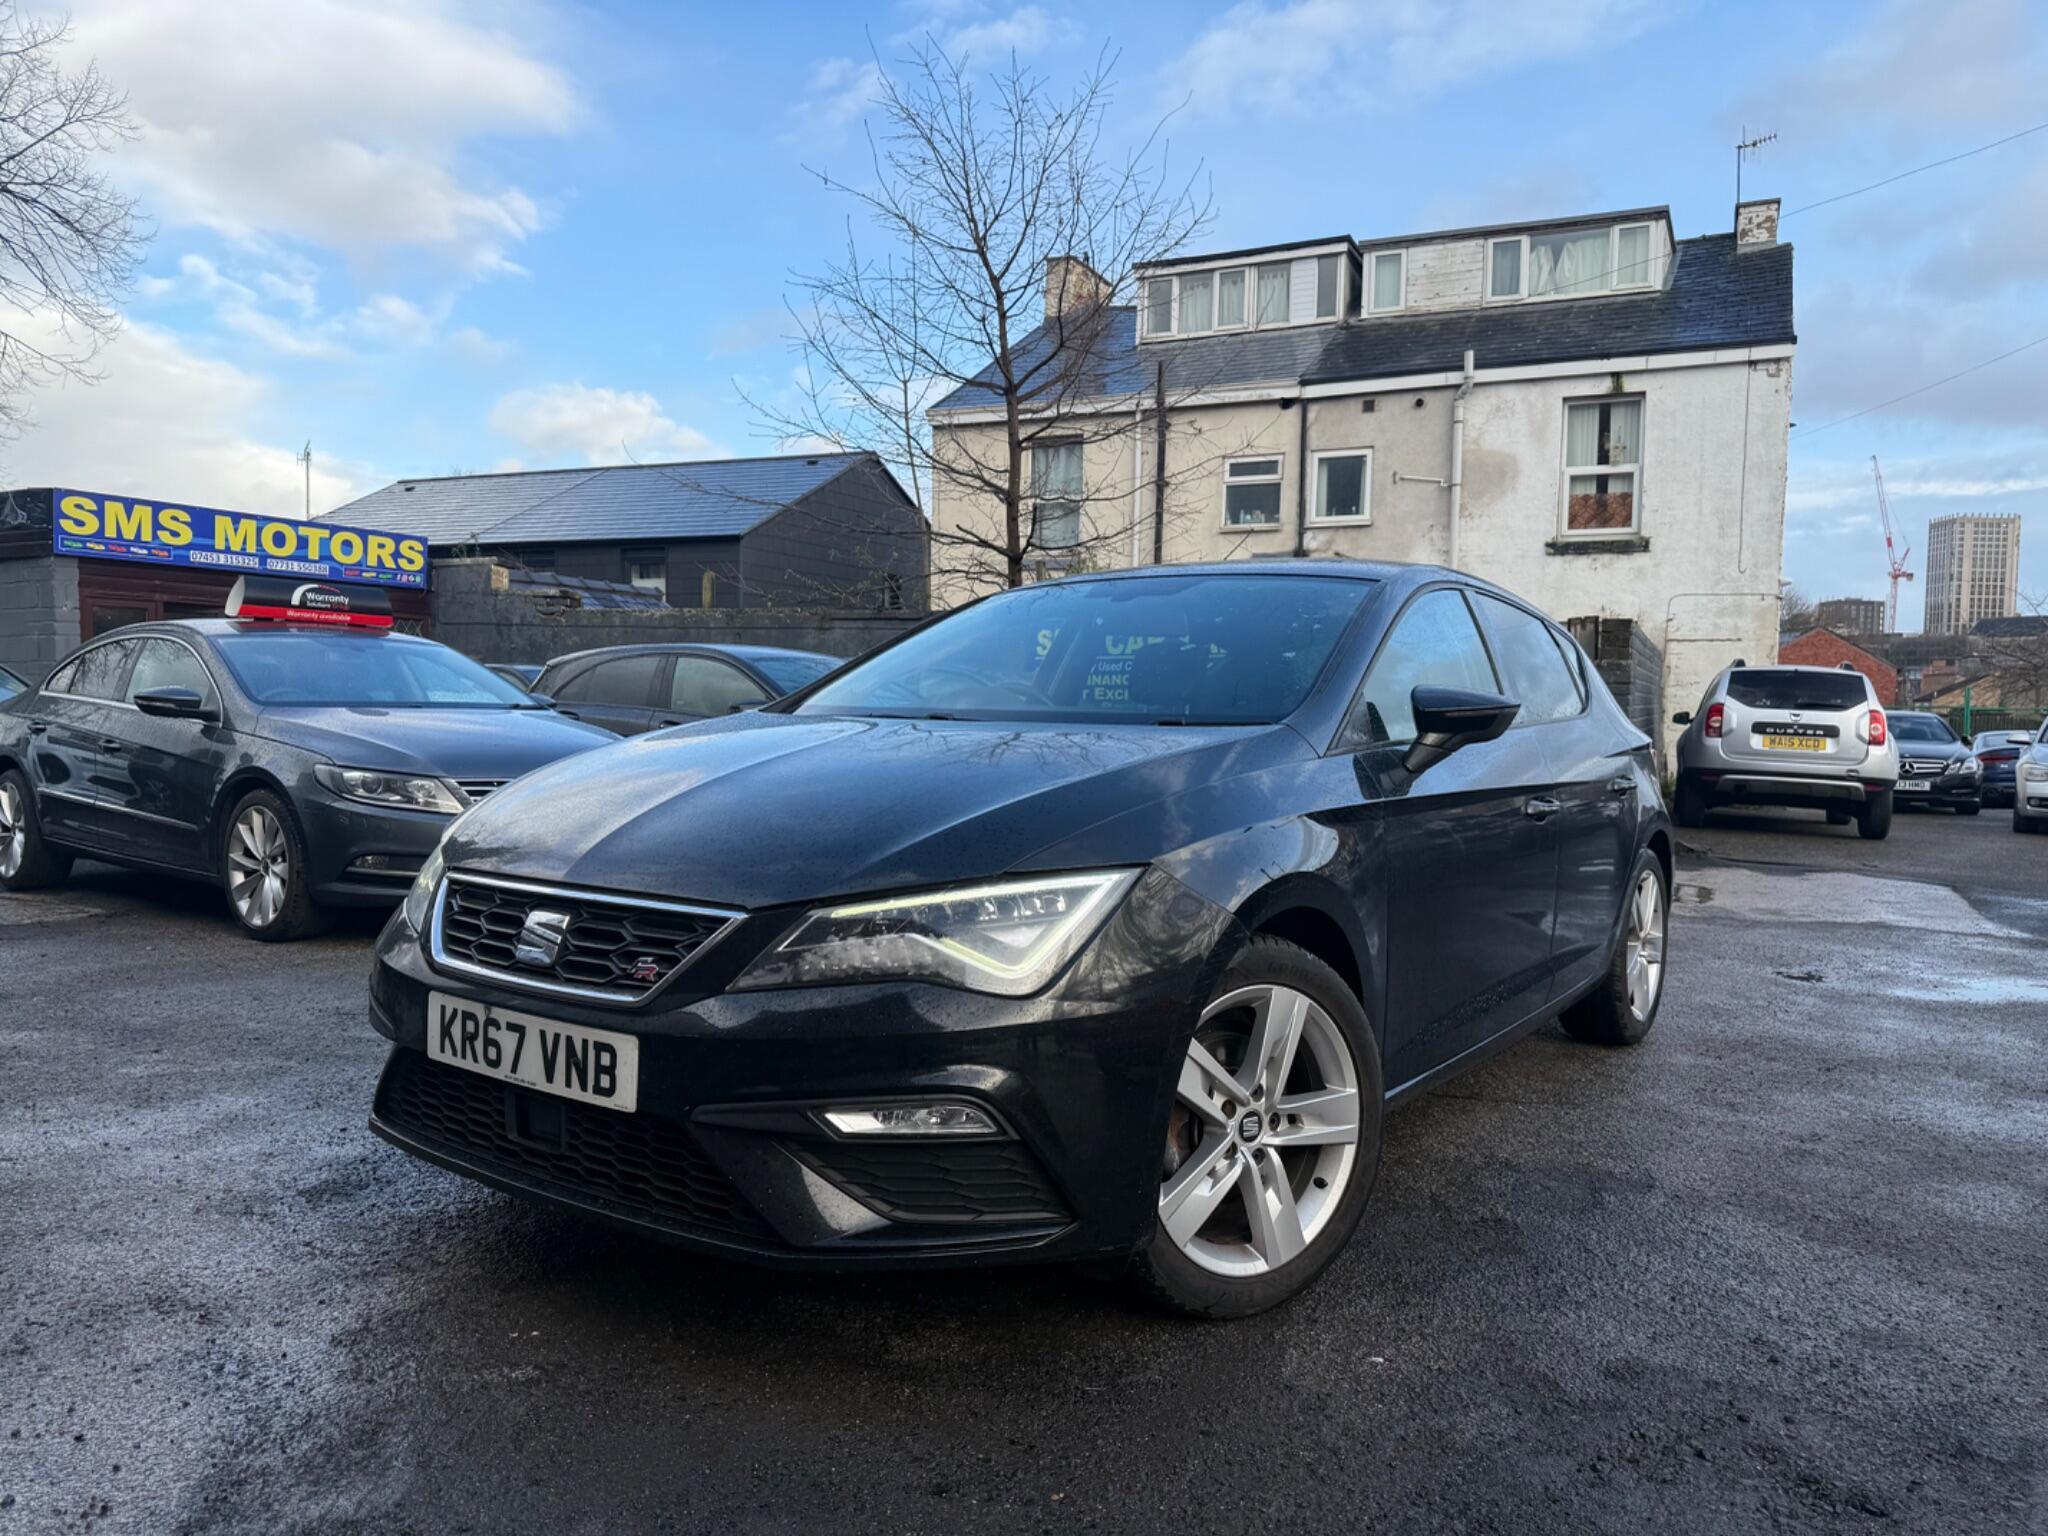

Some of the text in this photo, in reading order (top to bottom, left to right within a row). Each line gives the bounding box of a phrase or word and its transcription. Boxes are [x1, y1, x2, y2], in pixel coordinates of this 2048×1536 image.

[59, 496, 426, 571] SMS MOTORS
[287, 610, 352, 622] Warranty available
[305, 592, 350, 605] Warranty
[439, 1004, 618, 1099] KR67 VNB
